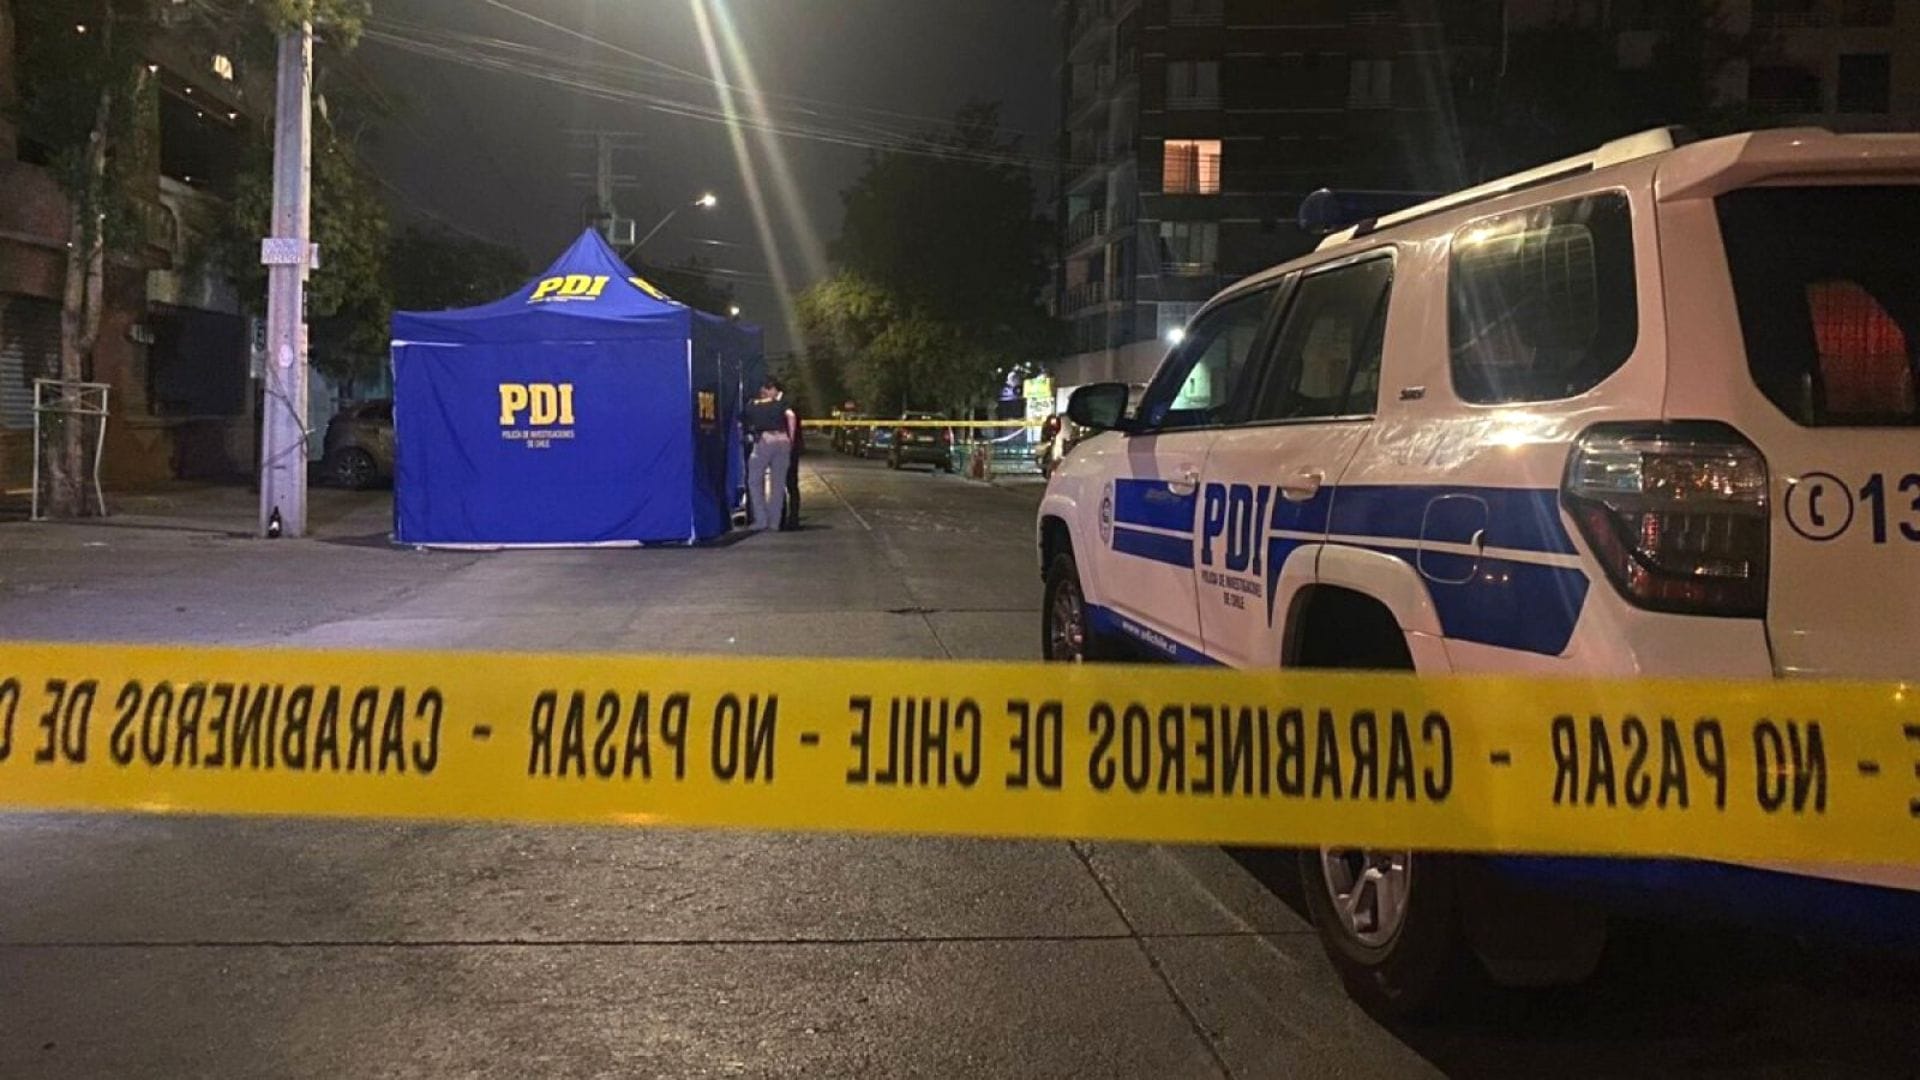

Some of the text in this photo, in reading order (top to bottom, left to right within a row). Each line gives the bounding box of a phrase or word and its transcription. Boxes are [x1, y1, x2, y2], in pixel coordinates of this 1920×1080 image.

[529, 275, 610, 299] PDI
[499, 384, 574, 425] PDI
[1201, 483, 1271, 577] PDI
